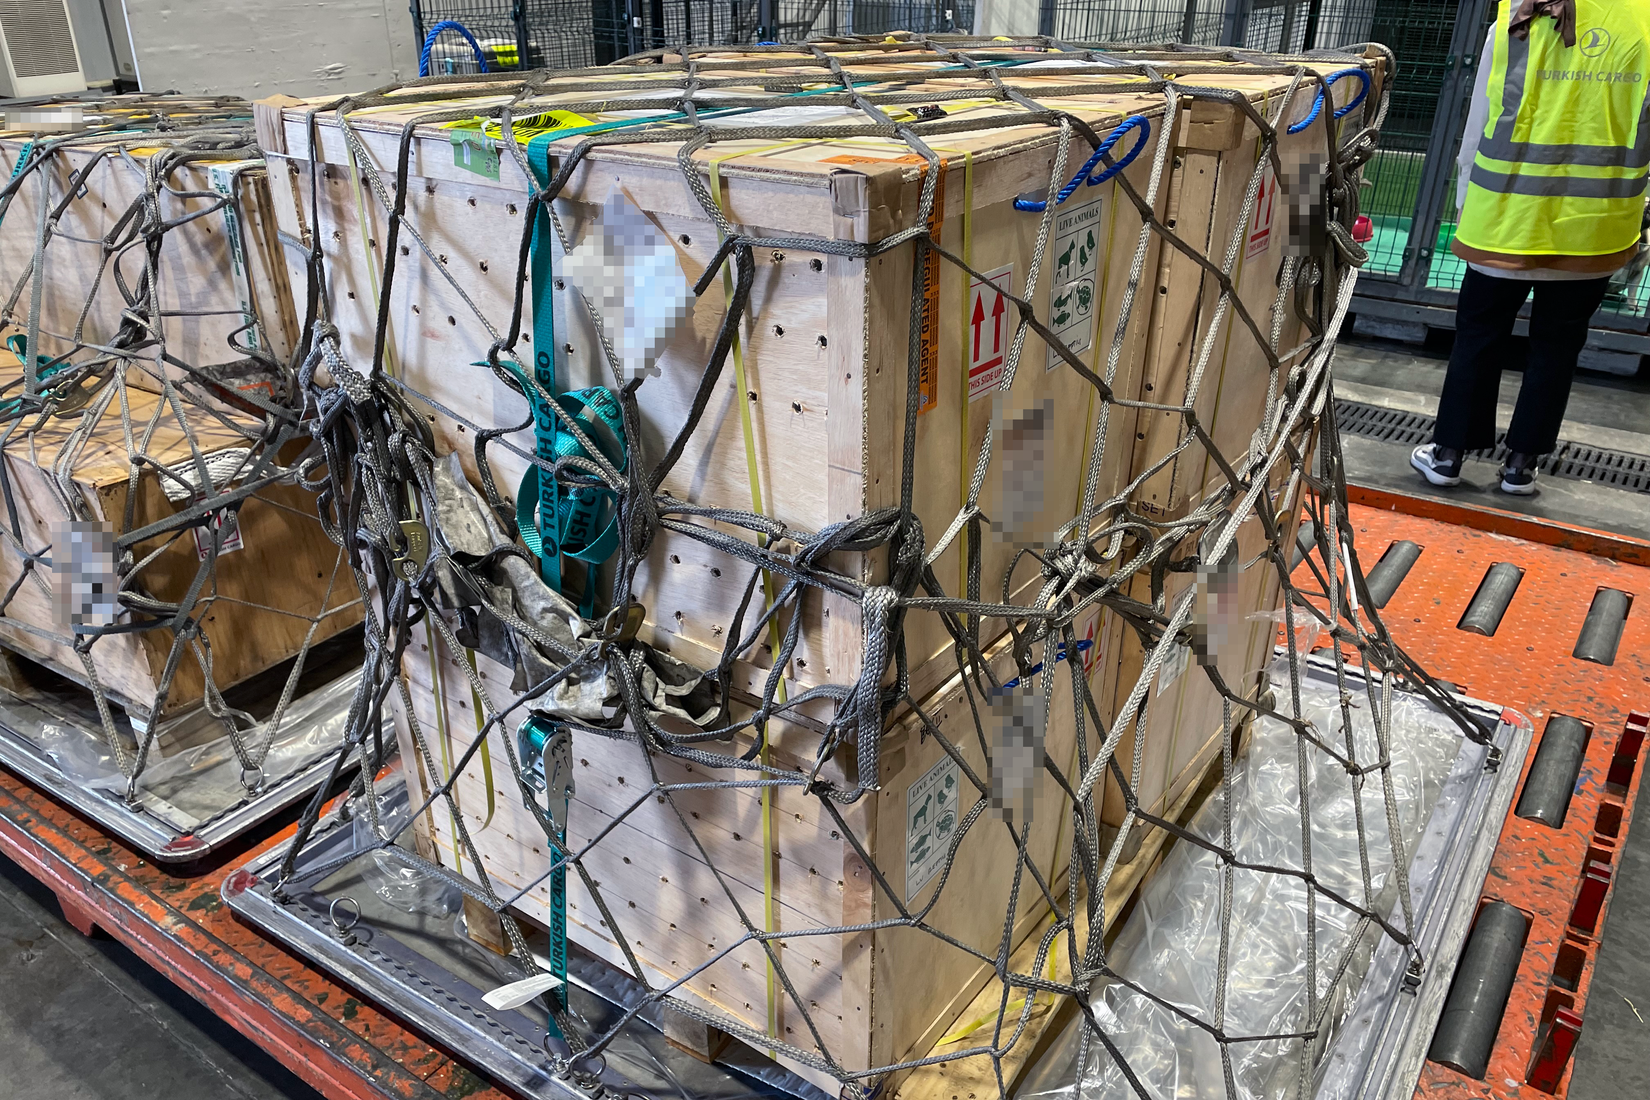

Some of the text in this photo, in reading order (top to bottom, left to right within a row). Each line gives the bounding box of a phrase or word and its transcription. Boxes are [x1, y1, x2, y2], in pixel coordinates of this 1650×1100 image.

[1536, 69, 1642, 83] TURKISH CARGO
[1059, 206, 1099, 231] LIVE ANIMALS
[920, 339, 929, 384] AGENT
[968, 368, 1002, 390] THIS SIDE UP
[537, 351, 552, 432] CAGO
[912, 757, 955, 798] LIVE ANIMAL
[552, 911, 564, 979] TURKISH
